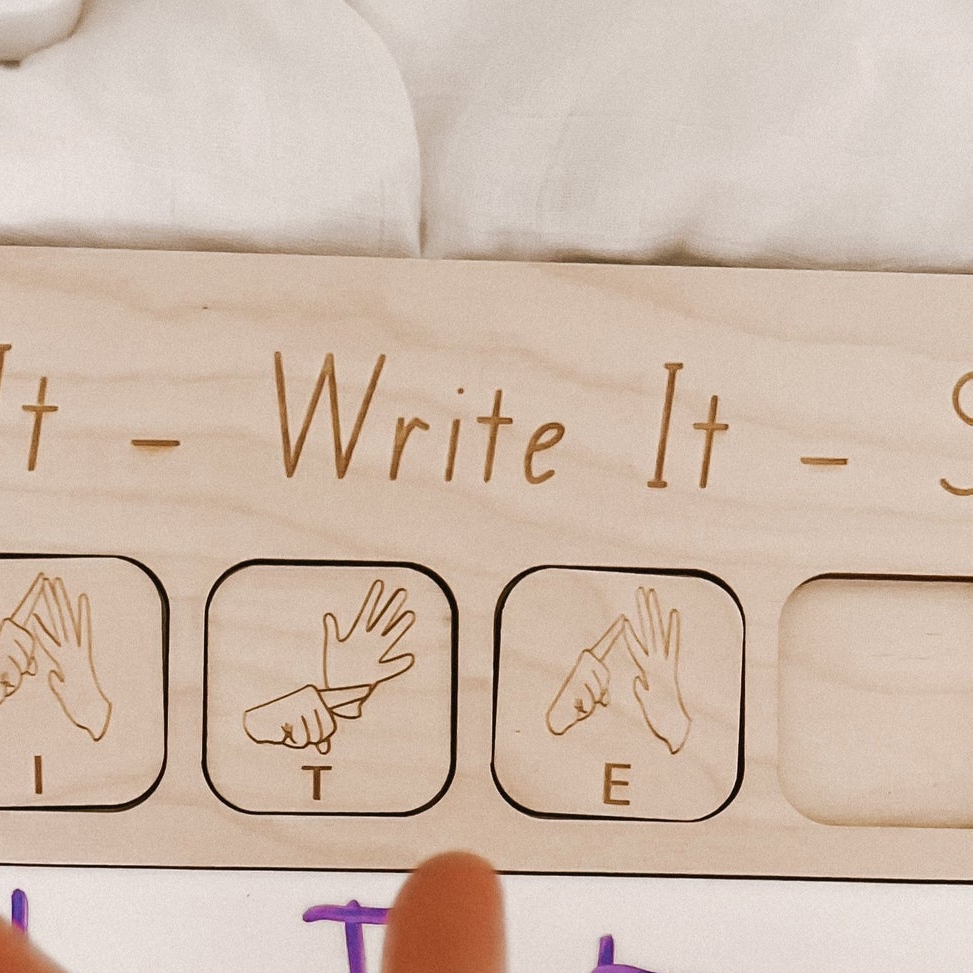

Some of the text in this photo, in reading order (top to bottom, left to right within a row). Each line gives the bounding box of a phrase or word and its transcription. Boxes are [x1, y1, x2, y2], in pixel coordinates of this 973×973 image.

[273, 350, 566, 485] Write
[647, 361, 729, 489] It
[33, 755, 43, 795] I
[301, 765, 333, 801] T
[603, 762, 632, 806] E
